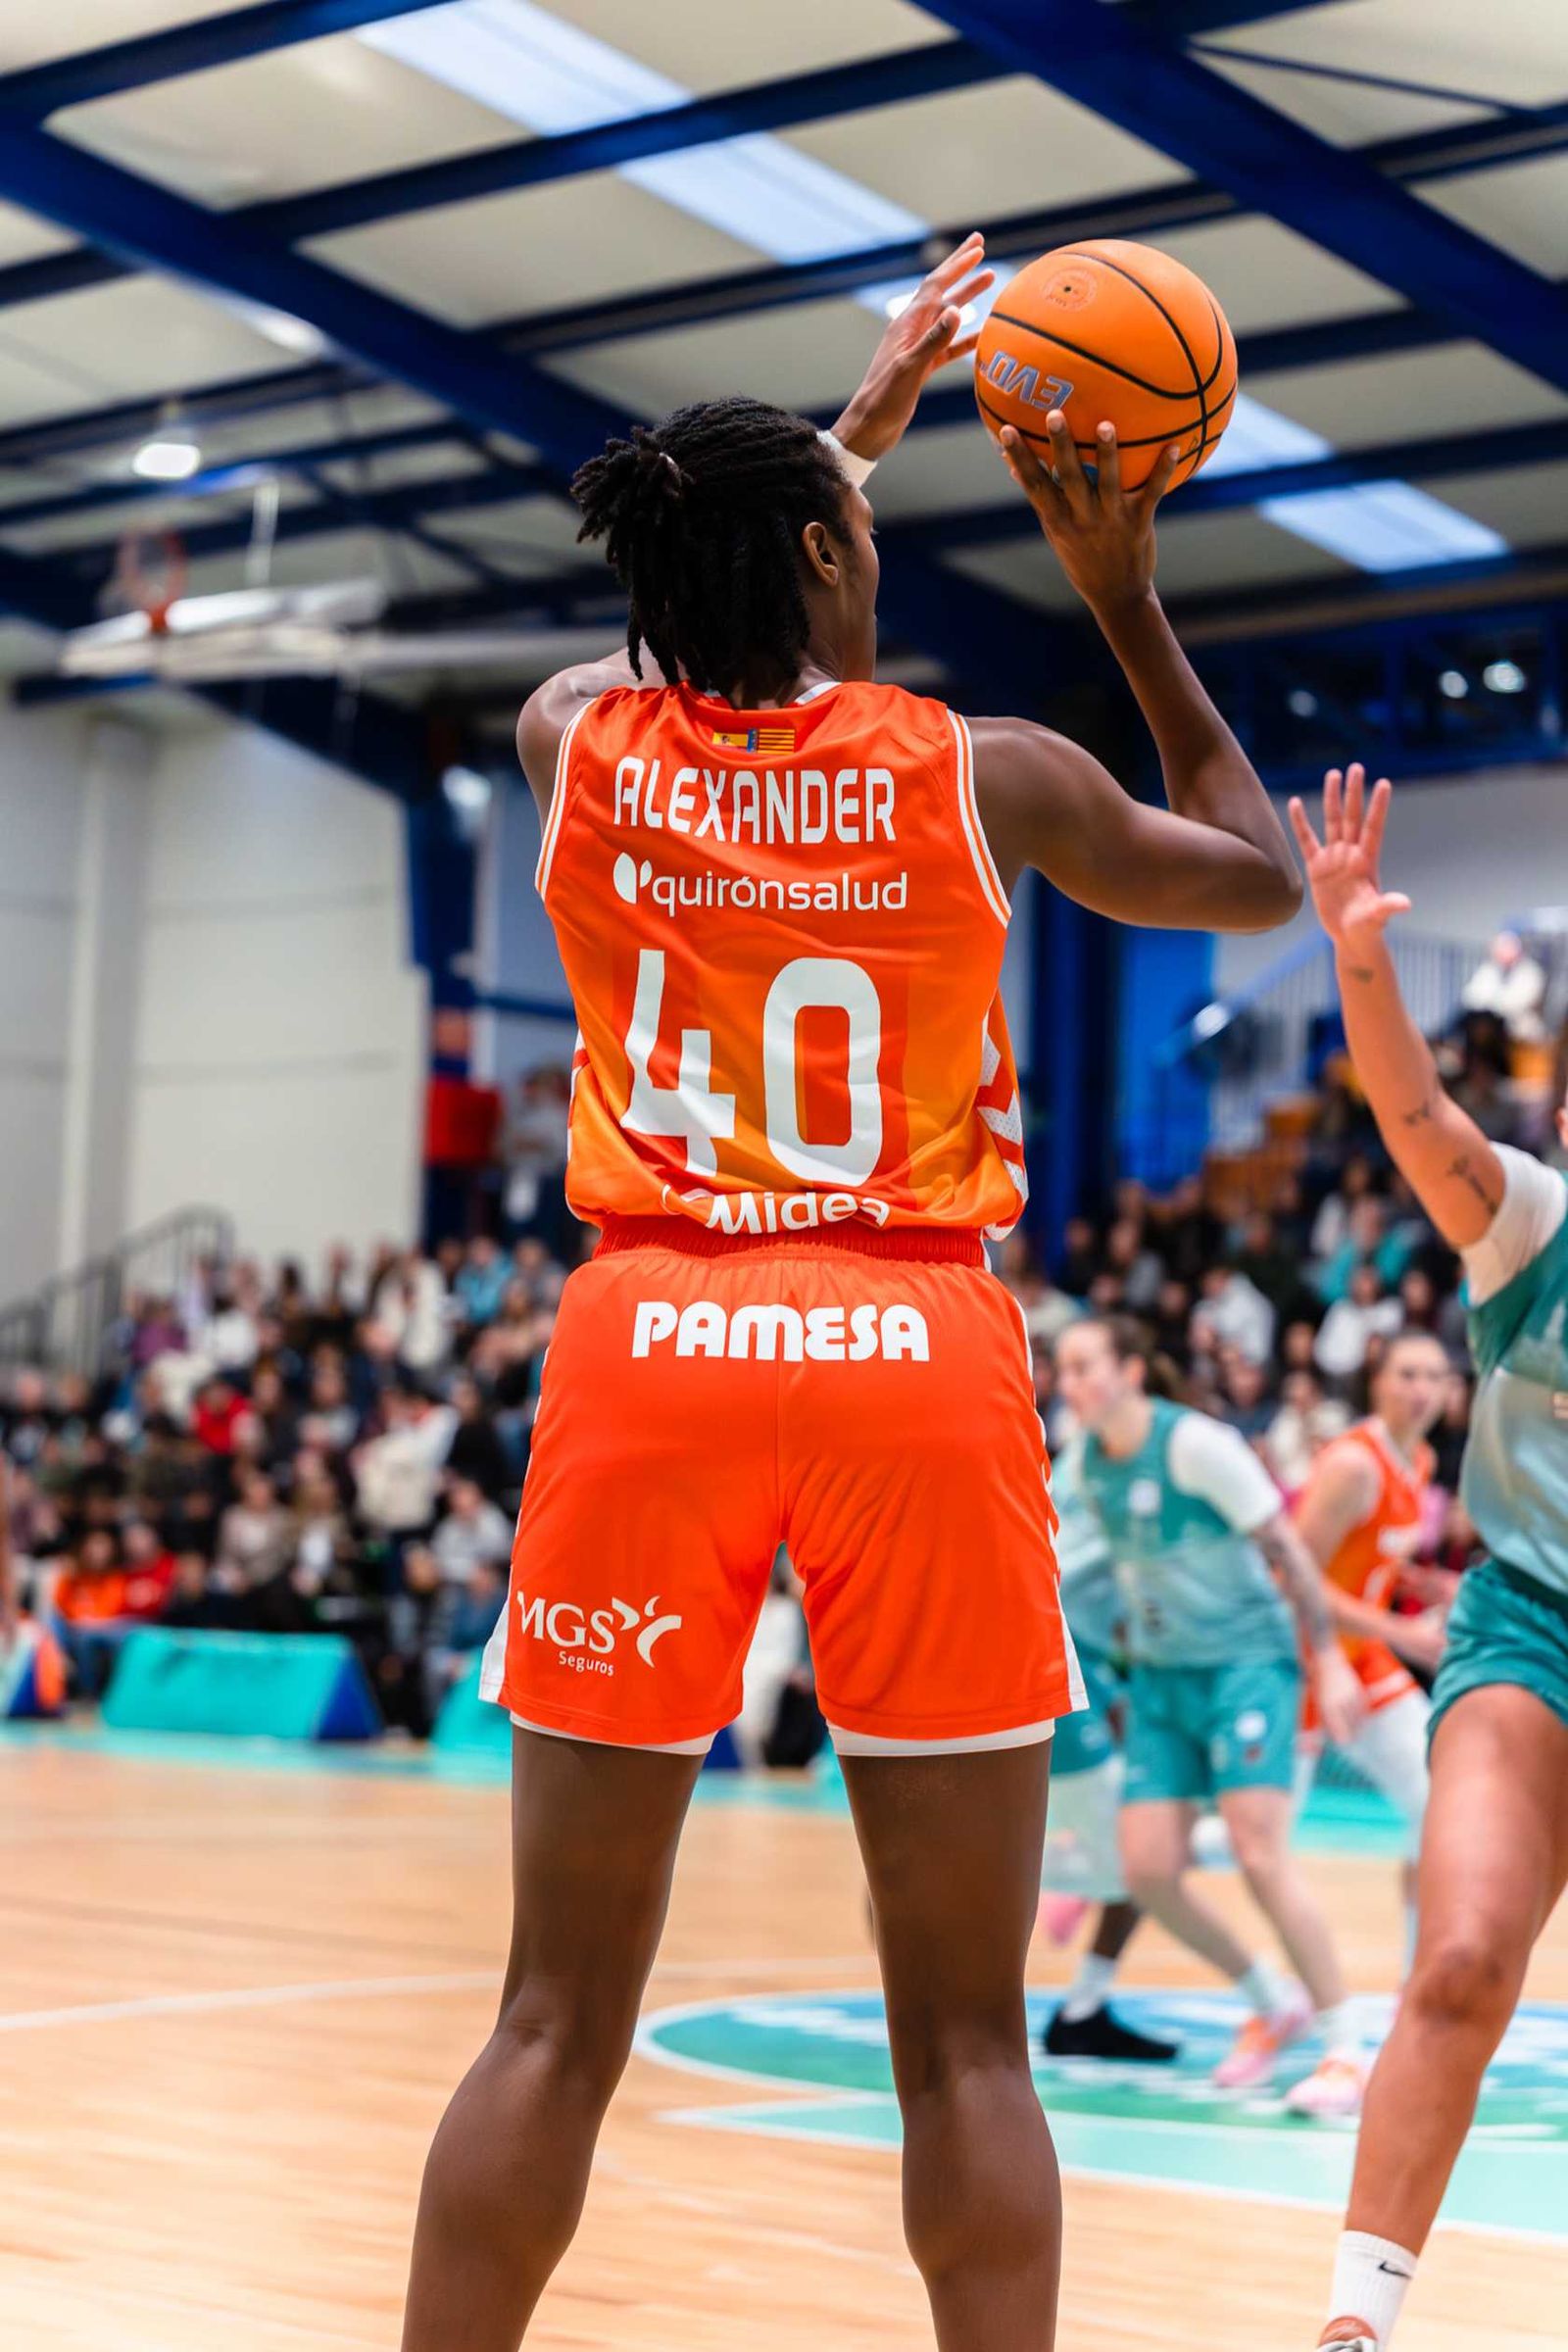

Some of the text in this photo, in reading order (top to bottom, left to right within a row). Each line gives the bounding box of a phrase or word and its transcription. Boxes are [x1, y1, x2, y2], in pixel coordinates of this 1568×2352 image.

[987, 350, 1074, 412] EVO
[613, 756, 896, 844] ALEXANDER
[652, 871, 907, 917] quirónsalud
[619, 949, 883, 1187] 40
[631, 1300, 930, 1362] PAMESA
[516, 1591, 615, 1654] MGS
[558, 1649, 614, 1677] Seguros
